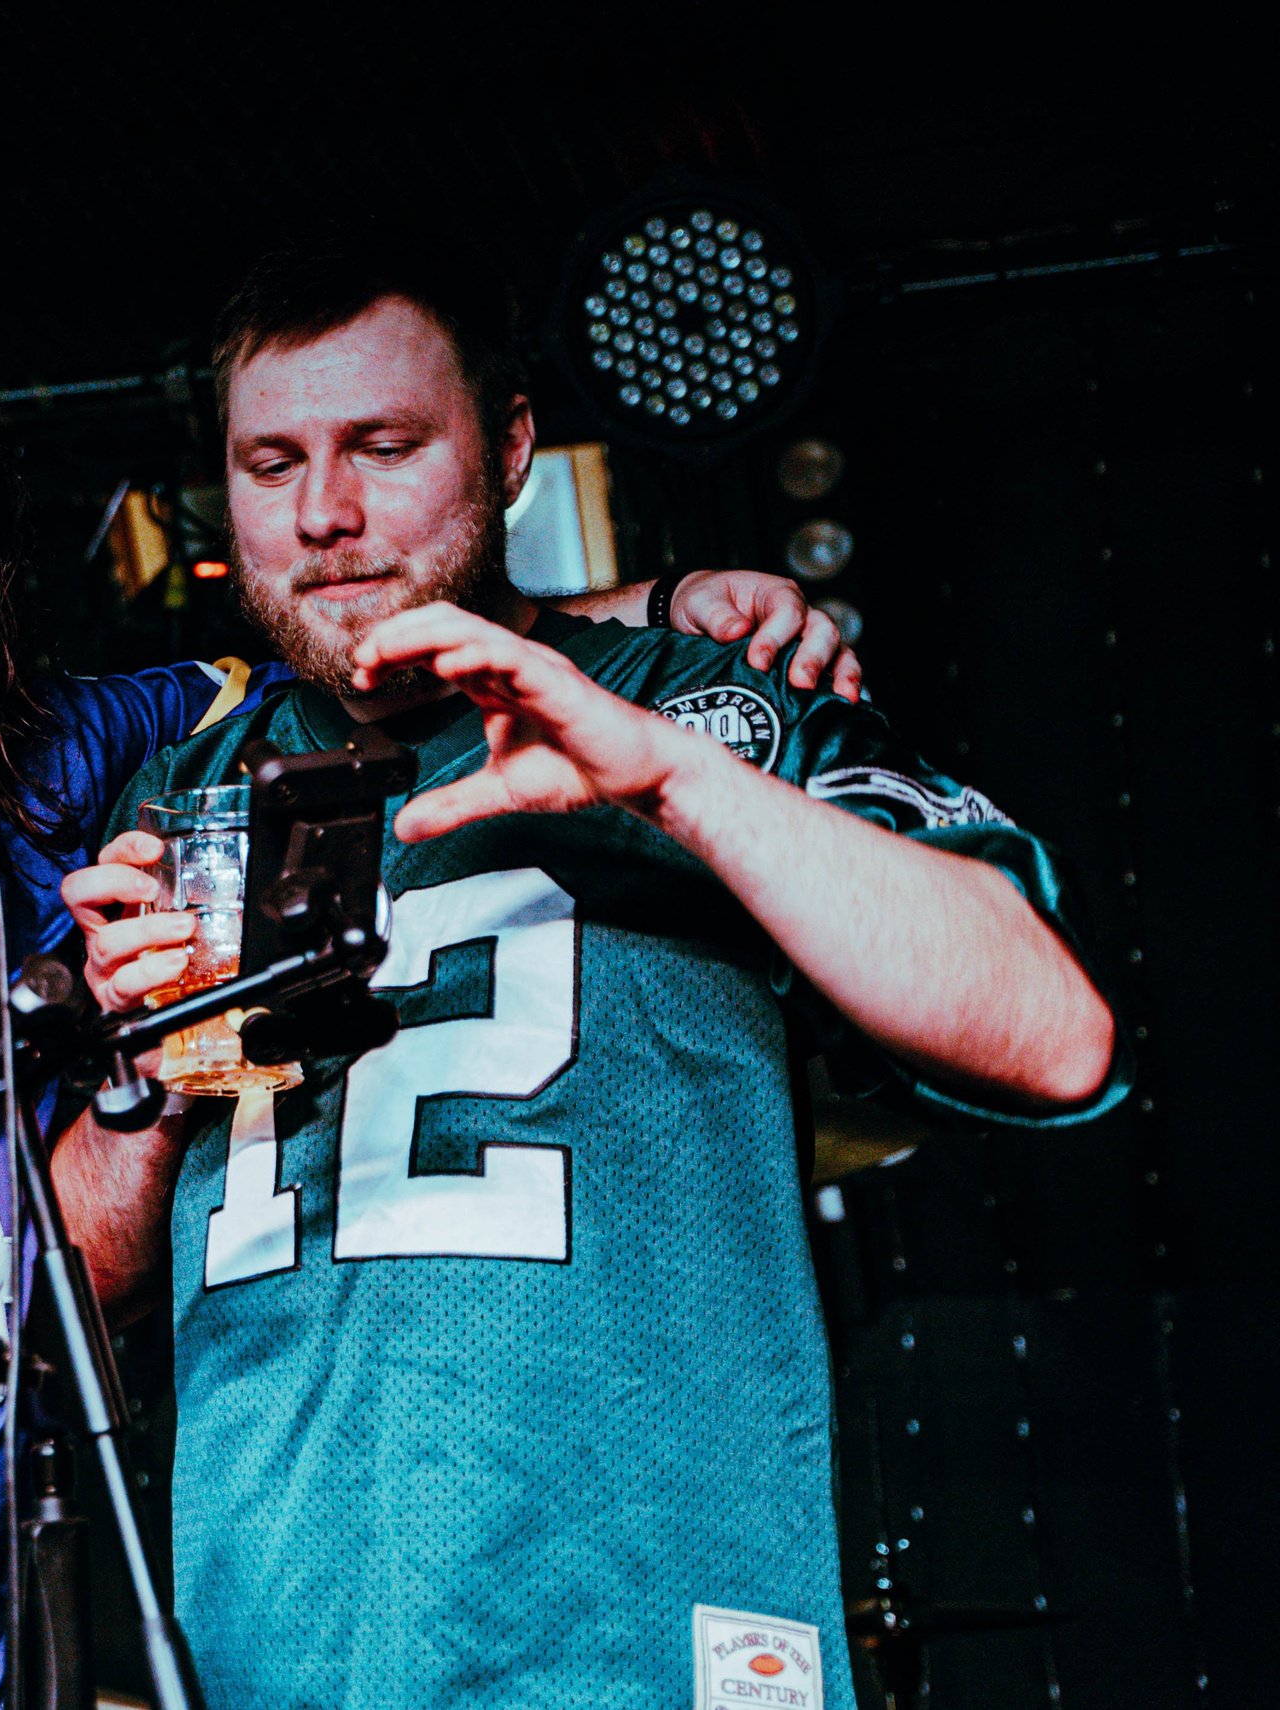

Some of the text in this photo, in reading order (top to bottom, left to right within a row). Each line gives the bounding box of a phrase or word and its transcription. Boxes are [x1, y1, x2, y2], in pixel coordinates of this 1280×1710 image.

[664, 692, 771, 740] OME BROWN
[713, 1633, 812, 1674] PLAYERS OF THE
[721, 1679, 808, 1707] CENTURY
